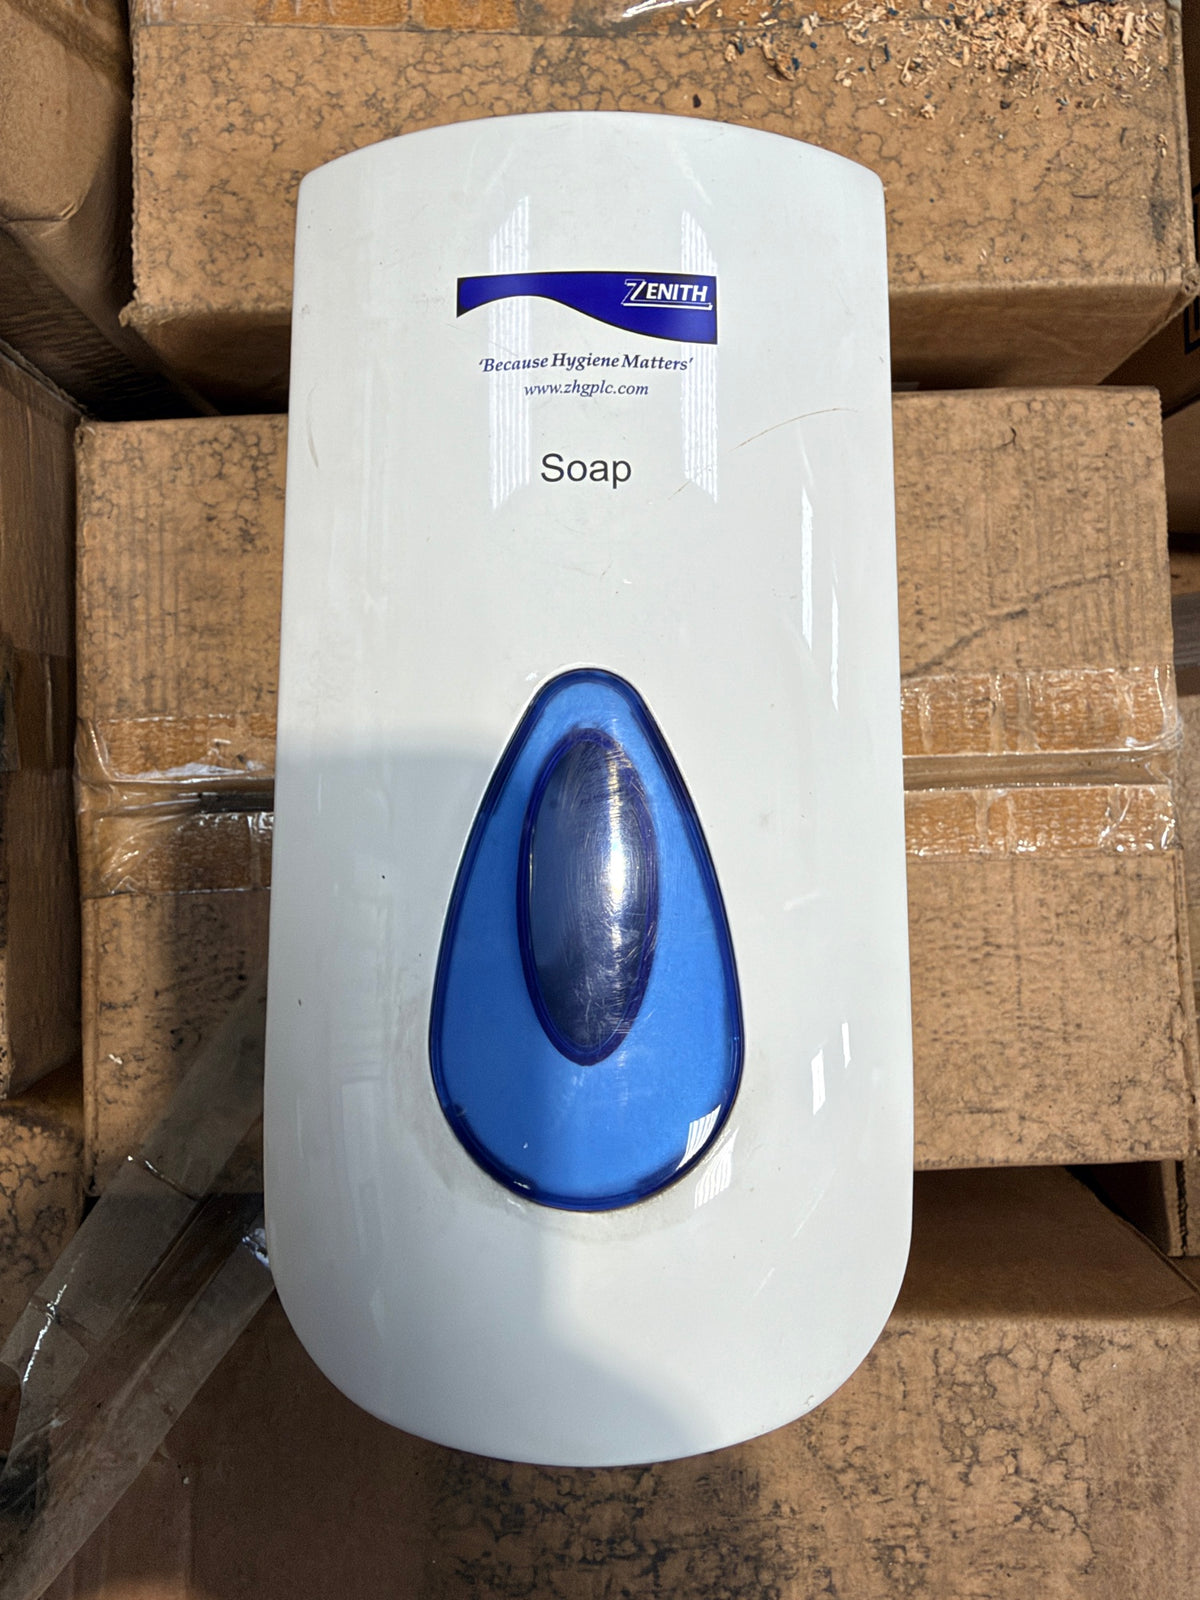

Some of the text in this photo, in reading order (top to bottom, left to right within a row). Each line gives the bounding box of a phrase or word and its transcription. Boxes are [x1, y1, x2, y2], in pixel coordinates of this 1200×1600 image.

[621, 278, 709, 306] ZENITH
[551, 352, 620, 371] Hygiene
[524, 379, 649, 398] www.zhgplc.com
[540, 453, 632, 489] Soap
